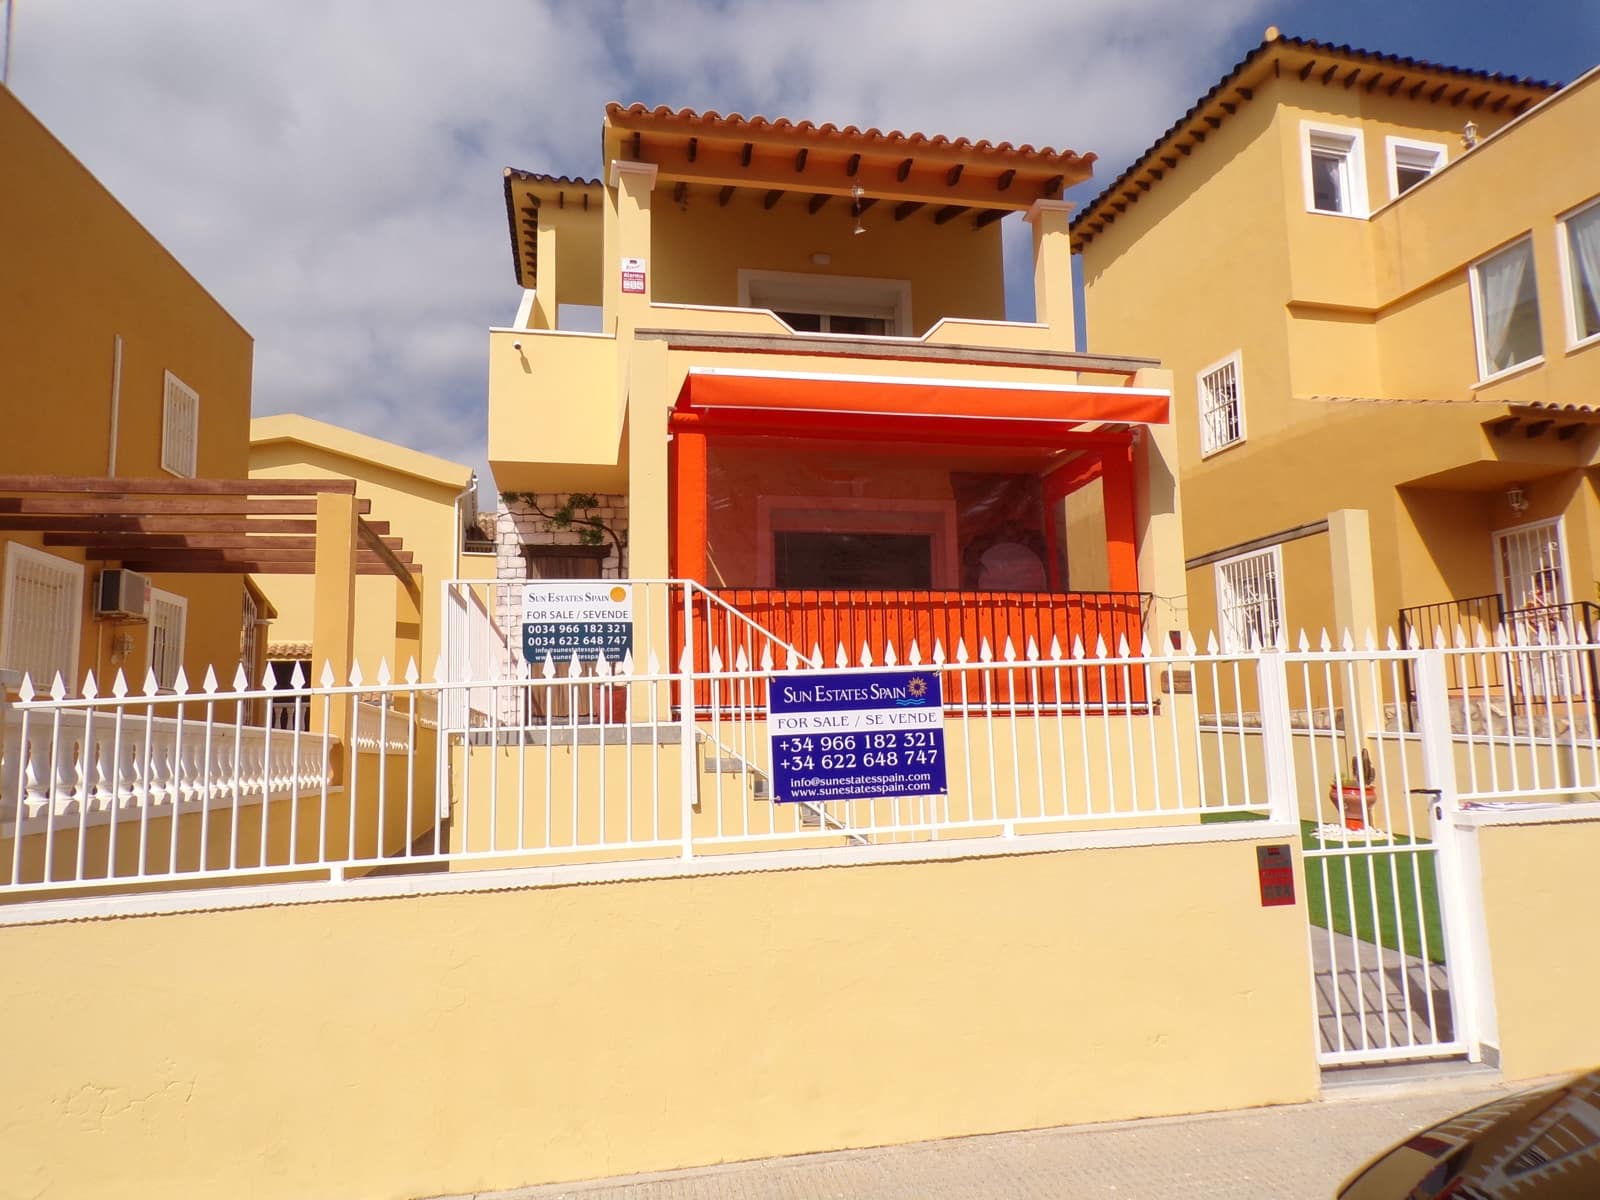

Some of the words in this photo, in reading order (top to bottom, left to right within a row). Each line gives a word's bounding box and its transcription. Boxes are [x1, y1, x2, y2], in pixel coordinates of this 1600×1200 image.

[528, 592, 548, 603] SUN
[548, 592, 583, 602] ESTATES
[585, 592, 609, 602] SPAIN
[526, 610, 547, 619] FOR
[550, 610, 574, 619] SALE
[583, 610, 630, 619] SEVENDE
[528, 625, 556, 634] 0034
[559, 624, 580, 633] 966
[584, 624, 604, 633] 182
[607, 624, 626, 633] 321
[528, 637, 556, 646] 0034
[559, 636, 580, 646] 622
[583, 636, 604, 645] 648
[607, 636, 627, 645] 747
[783, 686, 812, 703] SUN
[815, 685, 868, 702] ESTATES
[870, 683, 906, 699] SPAIN
[777, 717, 809, 729] FOR
[813, 715, 849, 728] SALE
[854, 715, 860, 728] /
[865, 714, 884, 725] SE
[889, 712, 937, 725] VENDE
[779, 737, 815, 753] +34
[820, 735, 856, 751] 966
[865, 733, 897, 749] 182
[903, 731, 936, 748] 321
[780, 755, 816, 771] +34
[821, 753, 857, 770] 622
[863, 751, 898, 768] 648
[904, 749, 938, 766] 747
[790, 772, 931, 788] info@sunestatesspain.com
[791, 782, 931, 798] www.sunestatesspain.com
